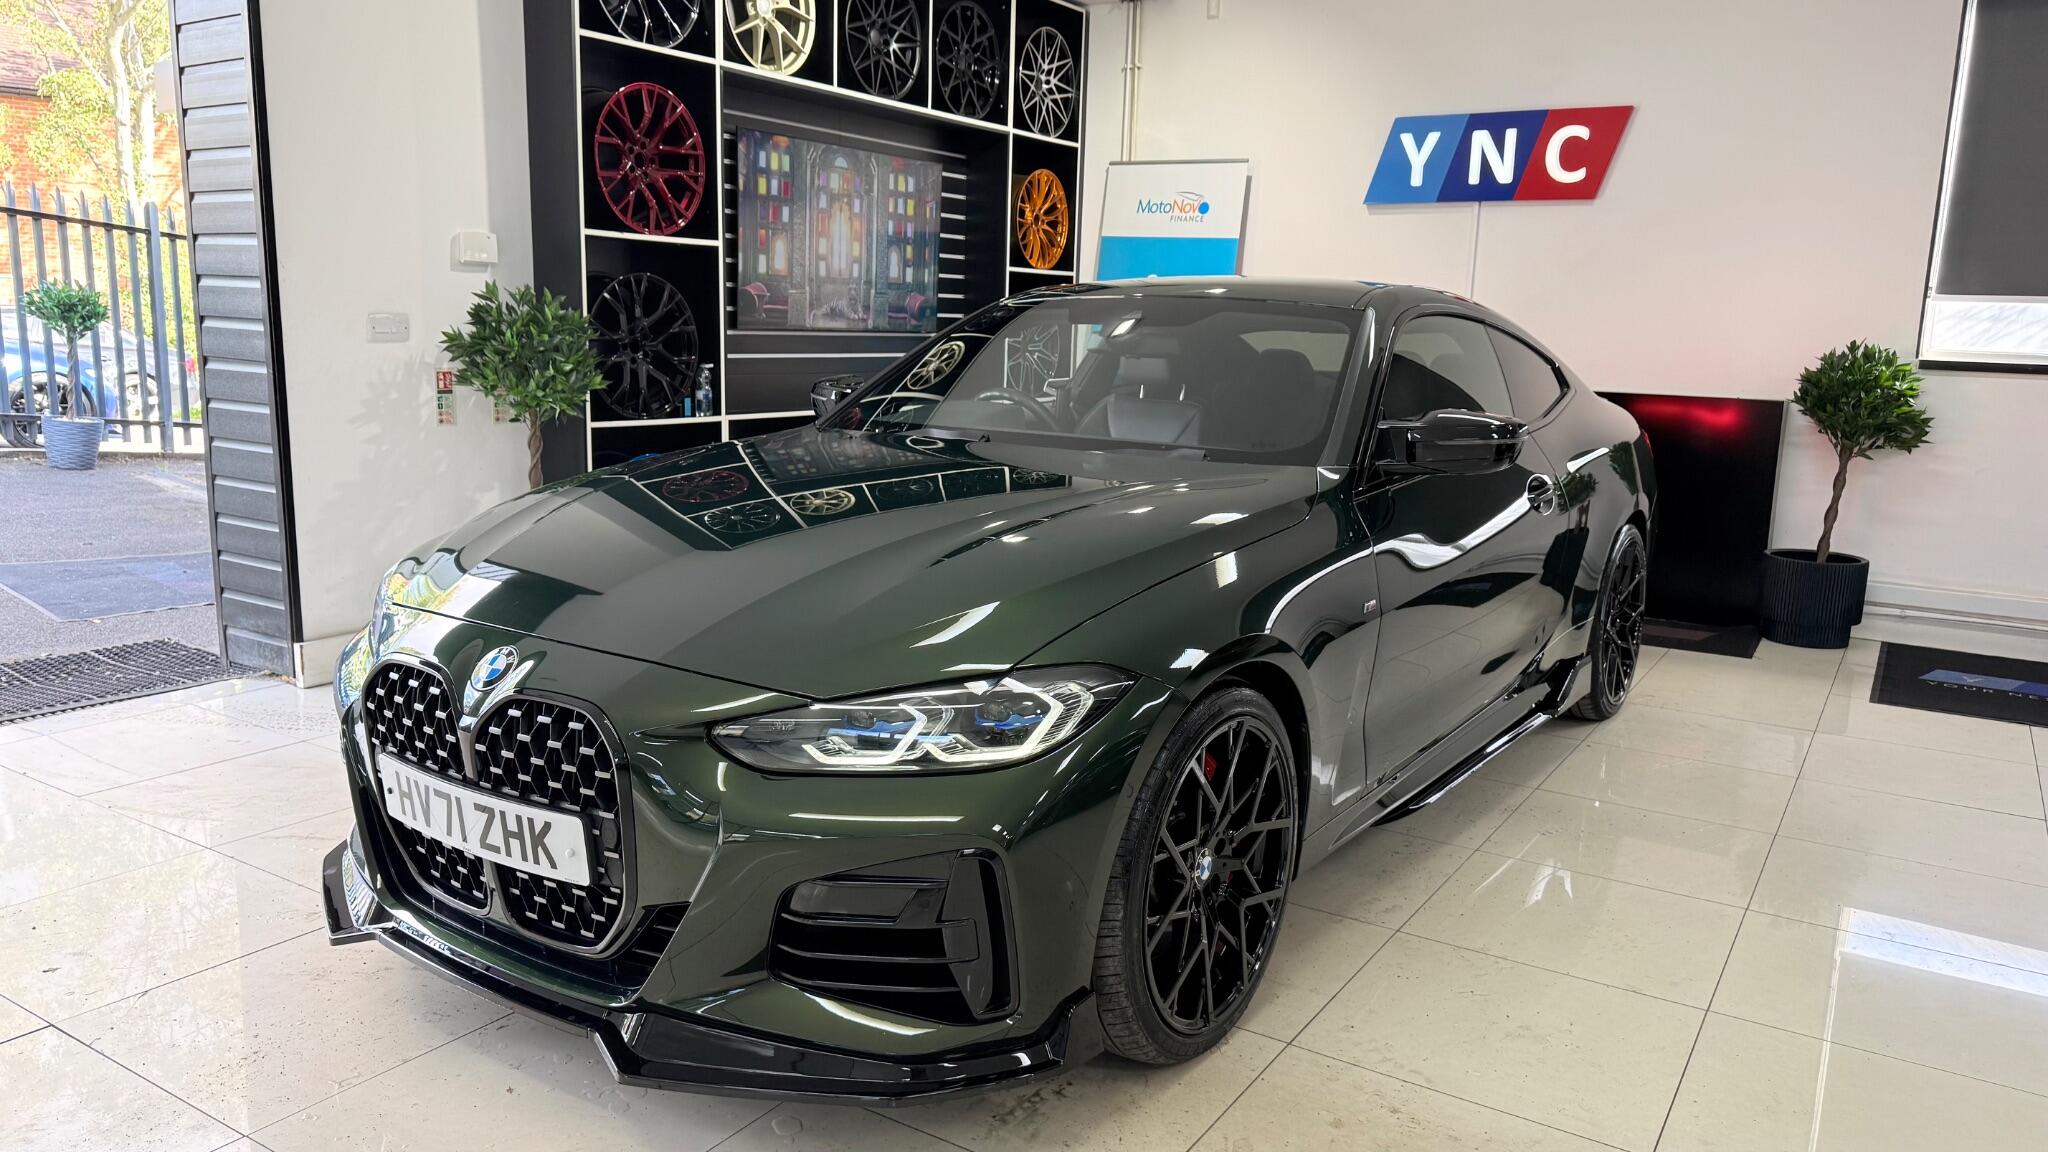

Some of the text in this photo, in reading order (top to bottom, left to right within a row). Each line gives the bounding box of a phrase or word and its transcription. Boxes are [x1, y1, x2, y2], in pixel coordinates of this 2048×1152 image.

[1400, 124, 1590, 187] YNC
[1136, 199, 1210, 215] MotoNovo
[1169, 215, 1205, 223] FINANCE
[1927, 681, 1993, 692] YOUR
[395, 770, 558, 870] HV71 ZHK
